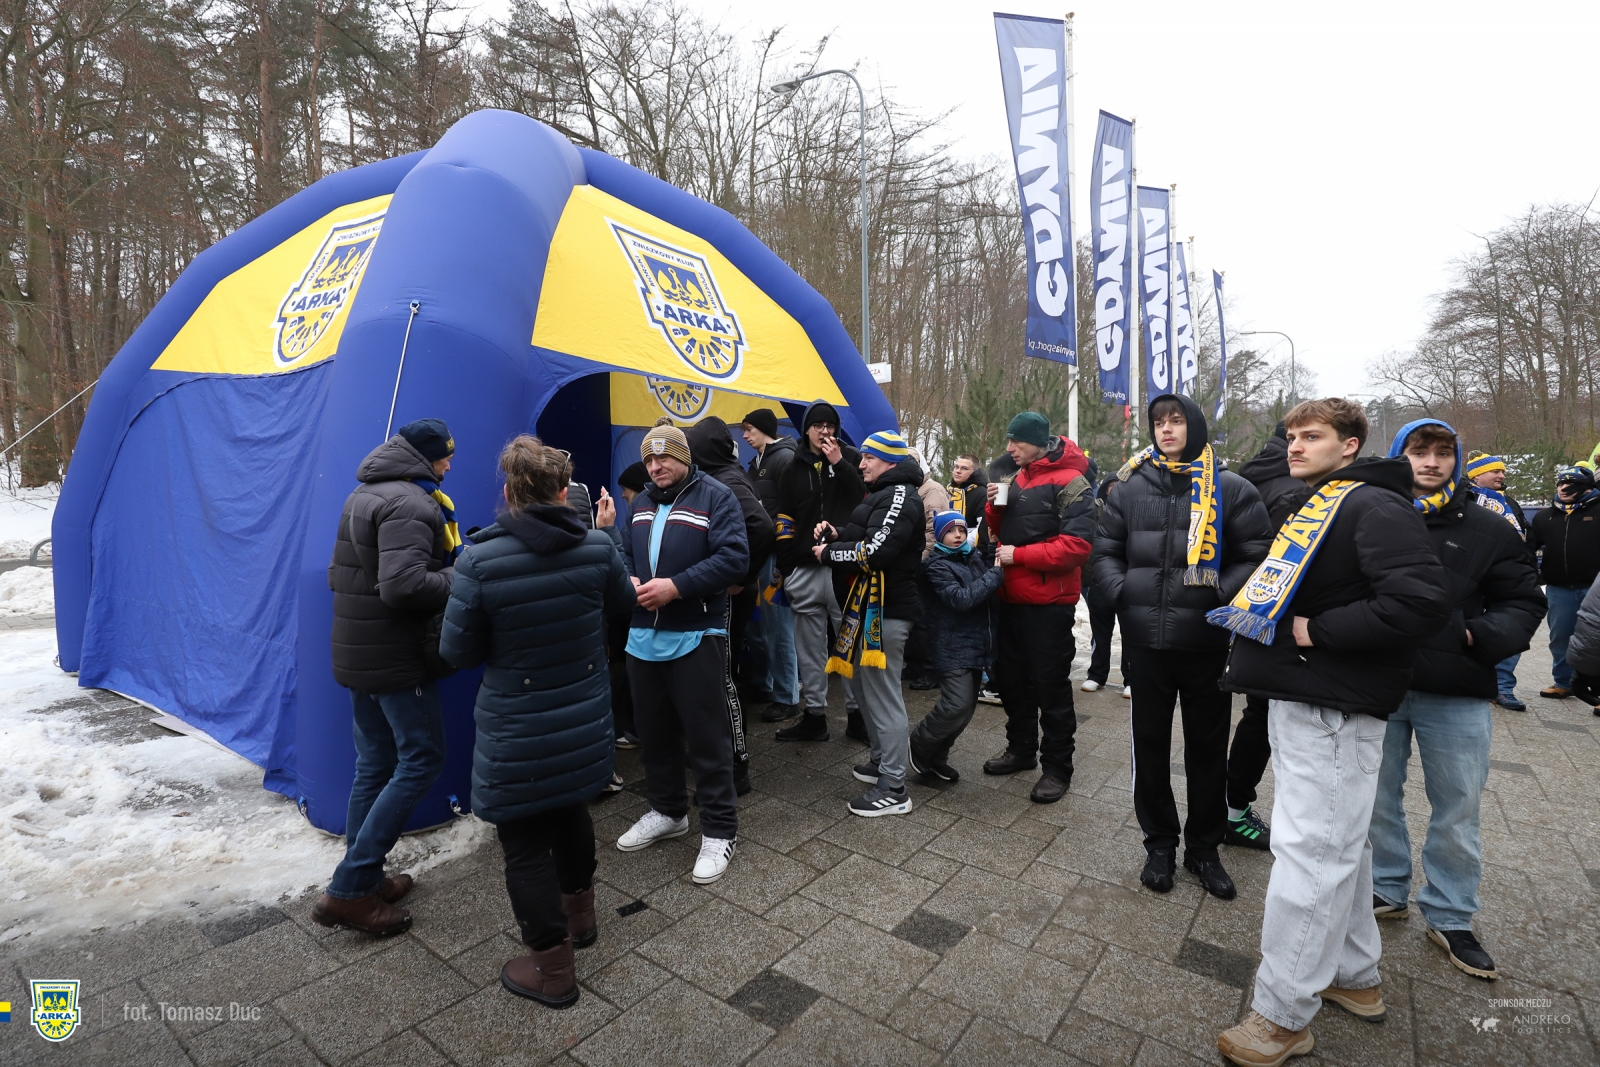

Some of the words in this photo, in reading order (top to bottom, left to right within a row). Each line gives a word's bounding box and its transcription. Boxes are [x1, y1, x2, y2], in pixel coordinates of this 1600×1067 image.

[292, 290, 341, 312] ARKA
[664, 304, 728, 335] ARKA
[882, 485, 906, 526] PITBULL
[1284, 480, 1355, 551] ARK
[1253, 582, 1274, 594] ARKA
